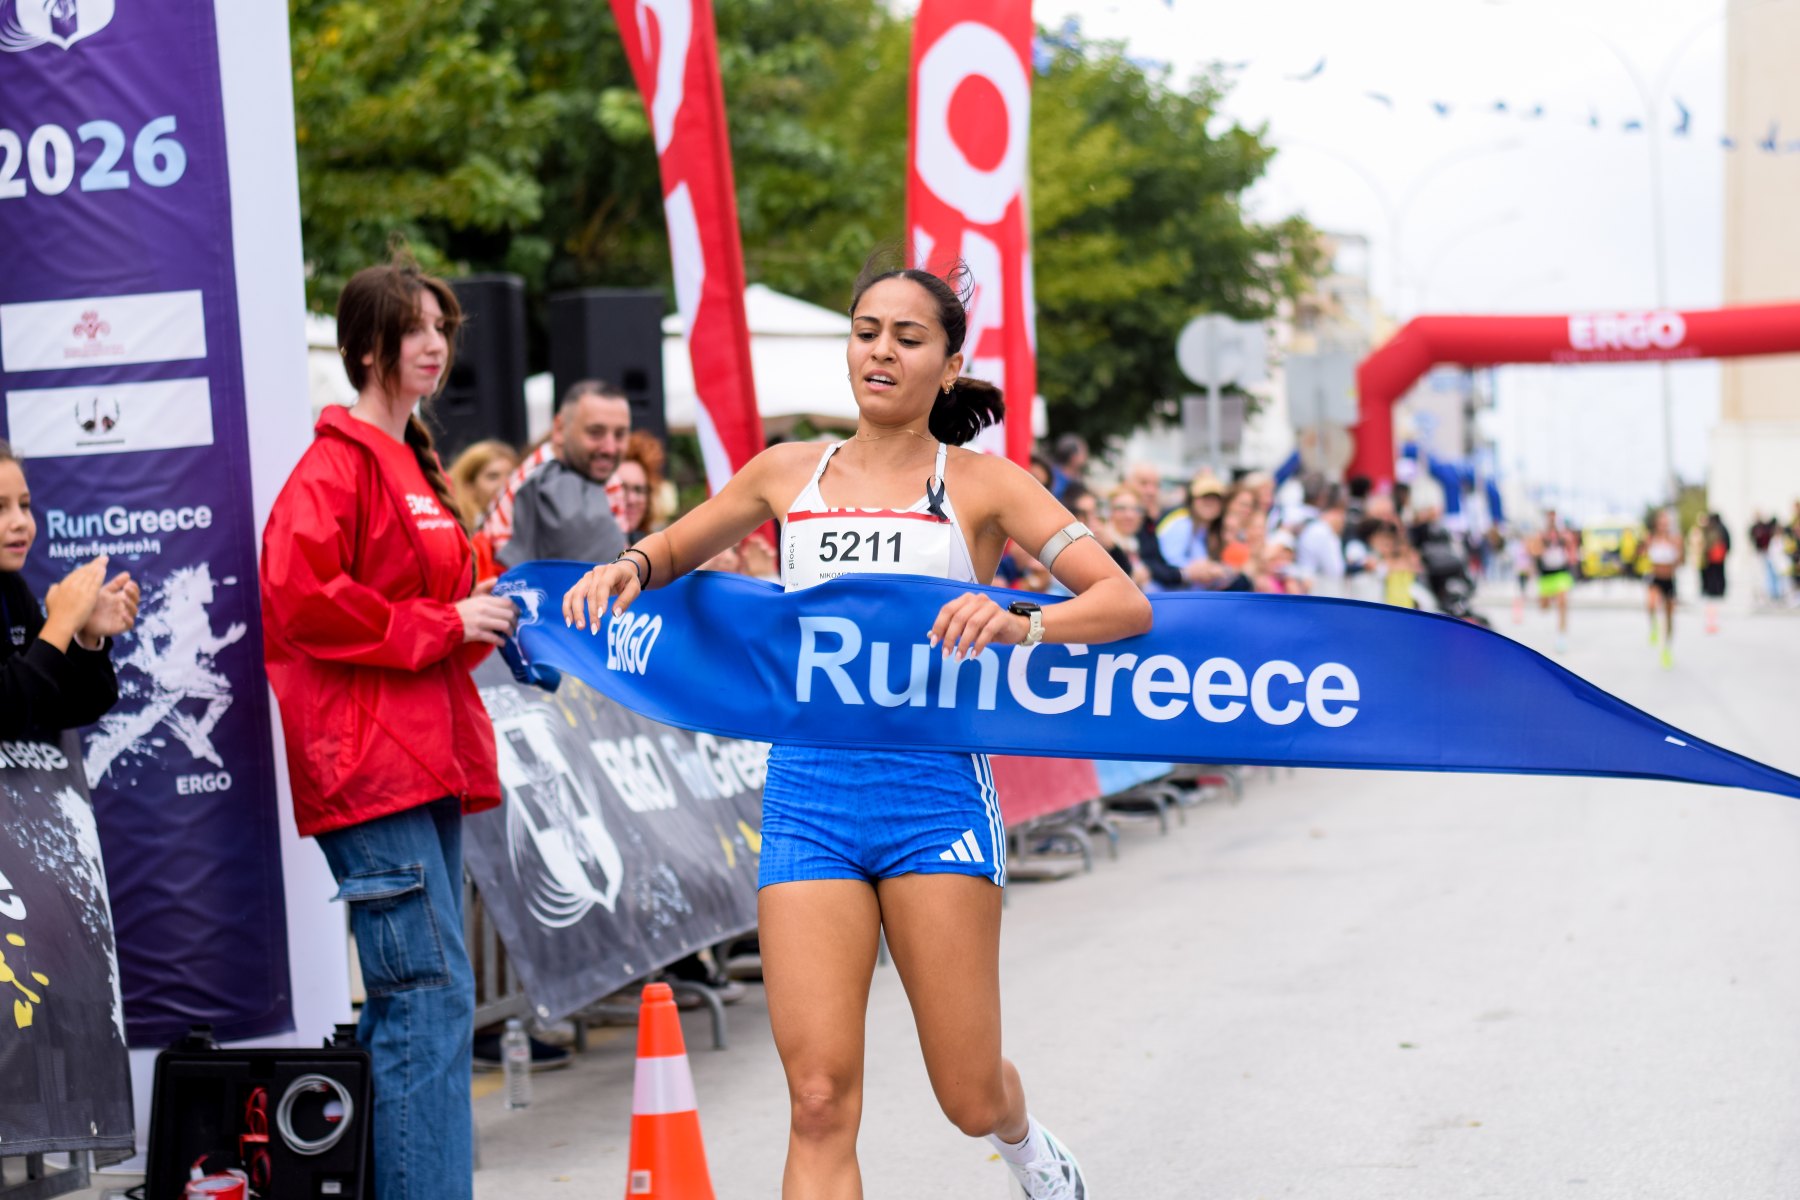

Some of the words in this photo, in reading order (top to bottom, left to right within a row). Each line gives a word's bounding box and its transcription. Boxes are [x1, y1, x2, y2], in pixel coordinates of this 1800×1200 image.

[1568, 311, 1687, 350] ERGO
[46, 505, 212, 539] RunGreece
[788, 543, 796, 570] Block
[819, 531, 902, 563] 5211
[607, 611, 662, 675] ERGO
[796, 615, 1360, 728] RunGreece
[176, 771, 232, 795] ERGO
